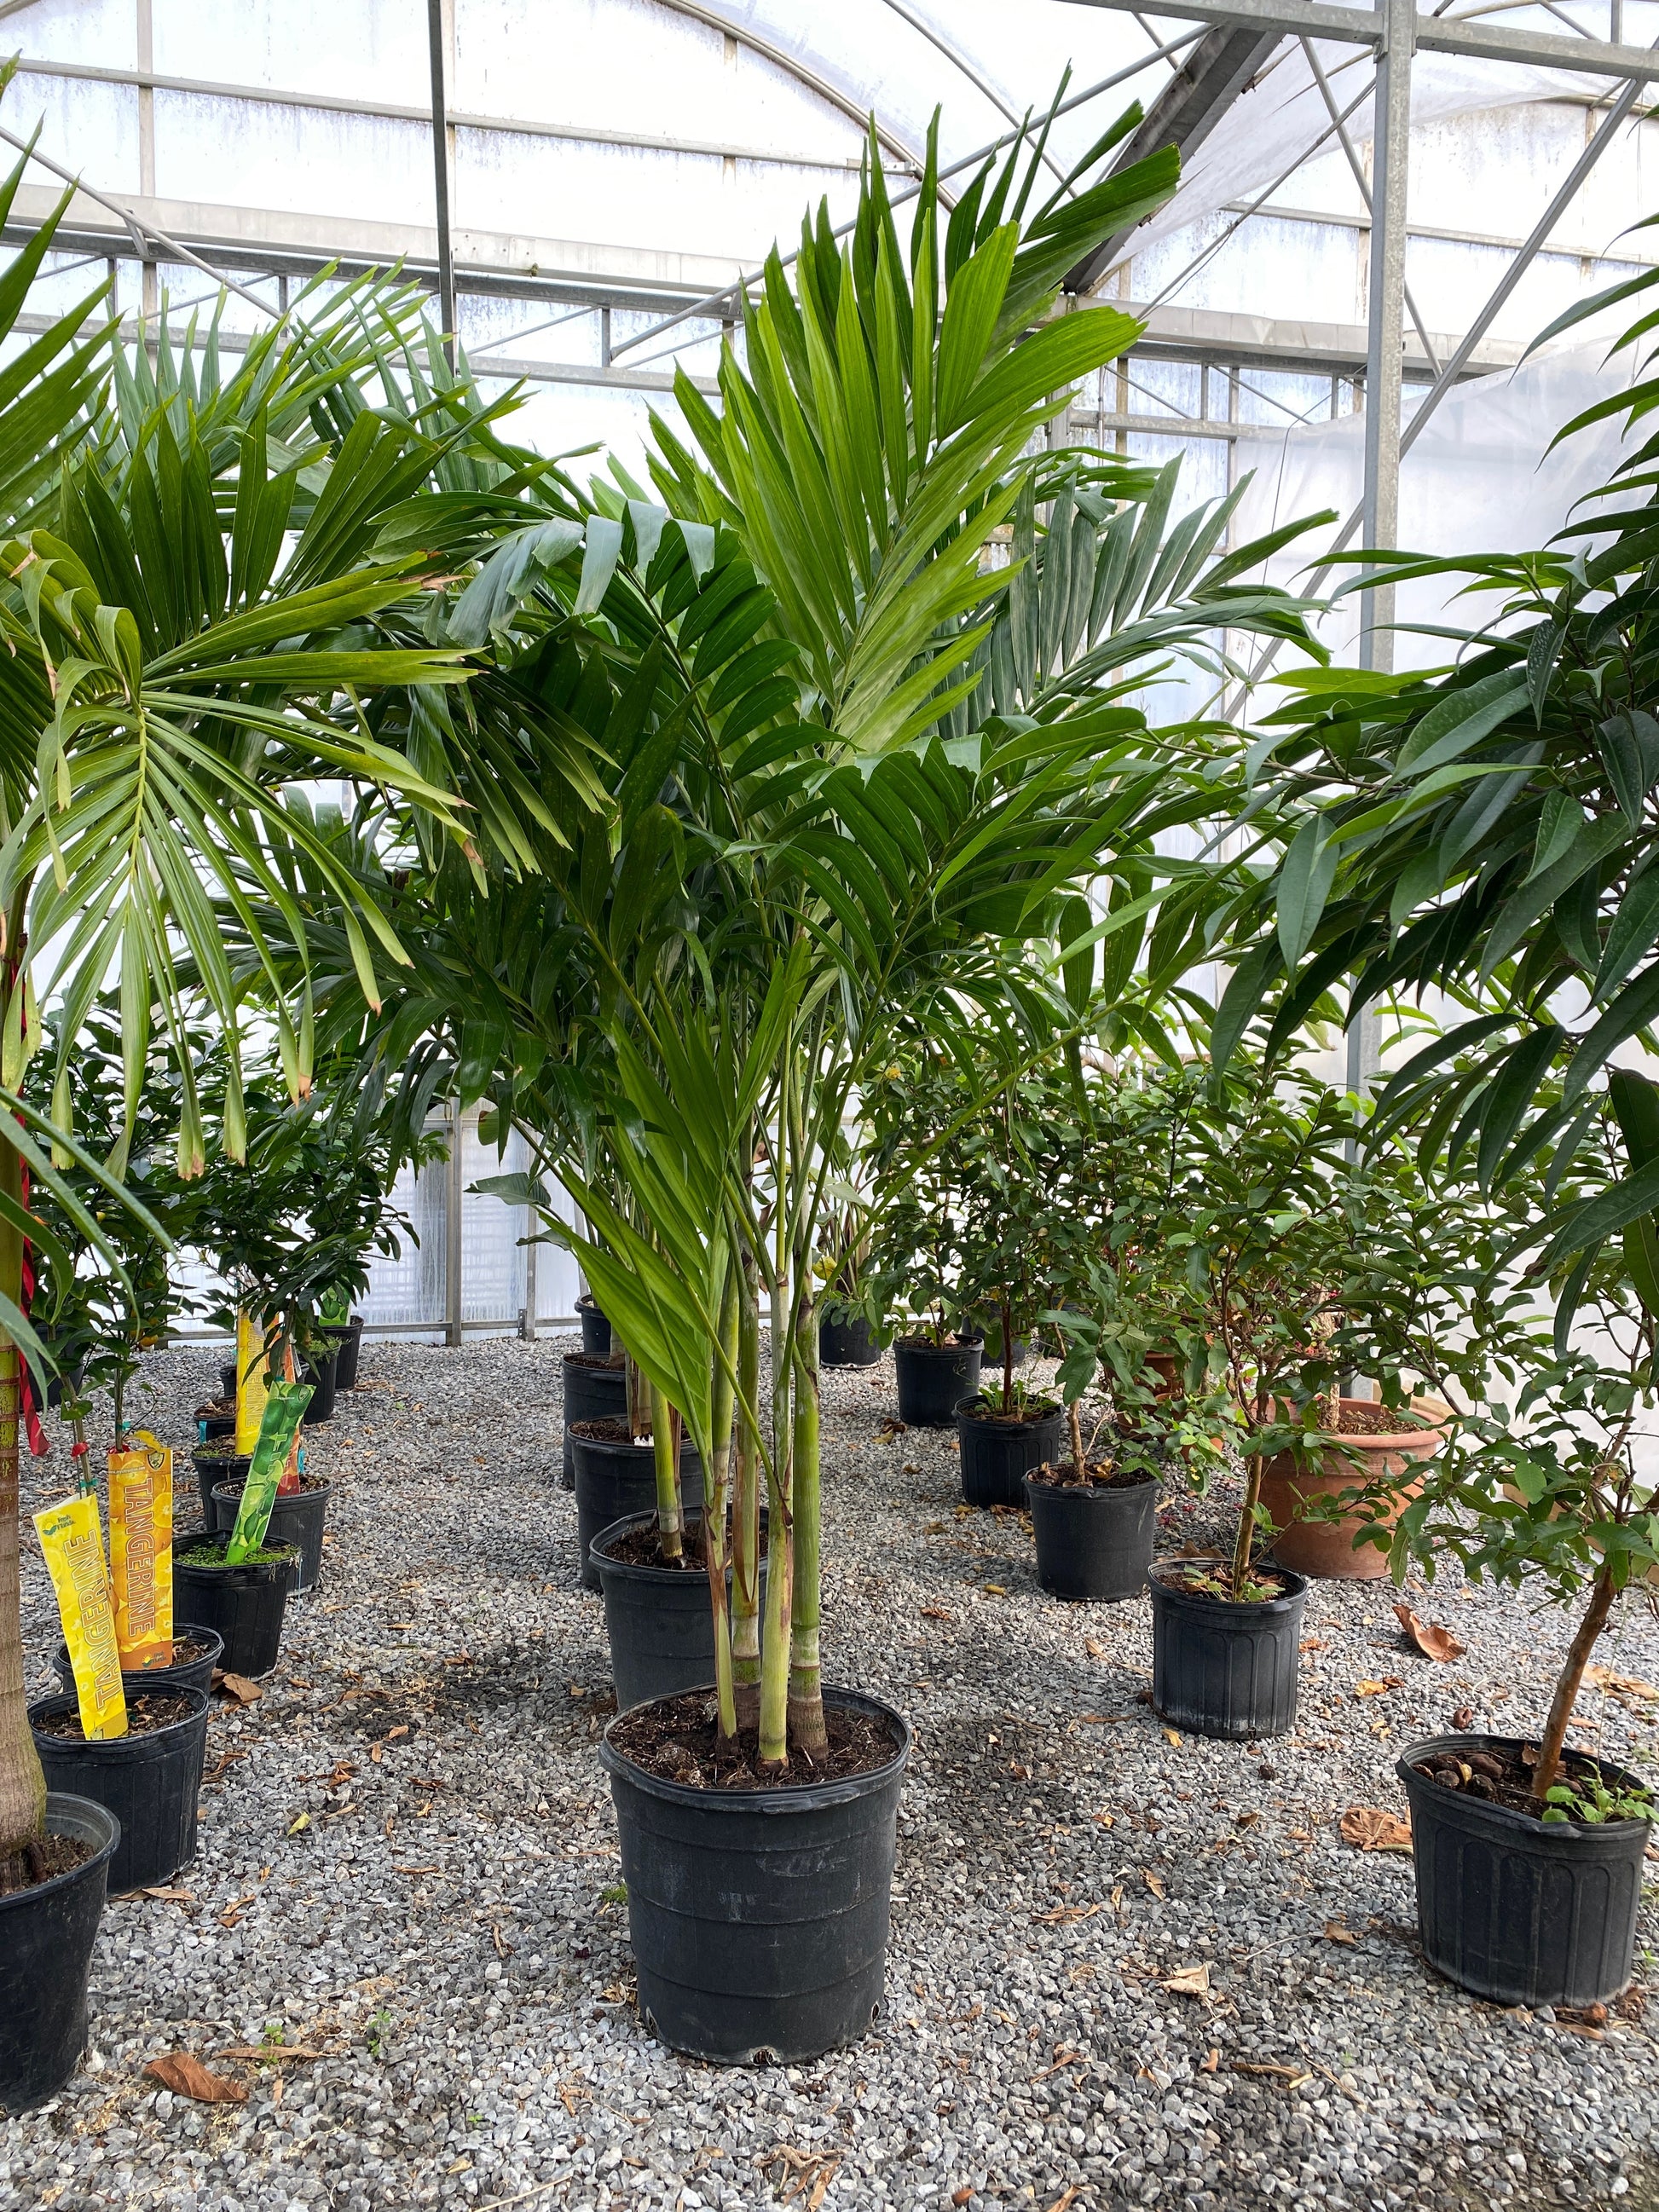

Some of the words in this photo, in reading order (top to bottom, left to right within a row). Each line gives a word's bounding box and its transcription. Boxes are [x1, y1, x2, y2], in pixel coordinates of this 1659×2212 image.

[246, 1325, 266, 1428] ANGERINE
[64, 1529, 121, 1710] TANGERINE
[124, 1477, 155, 1637] TANGERINE
